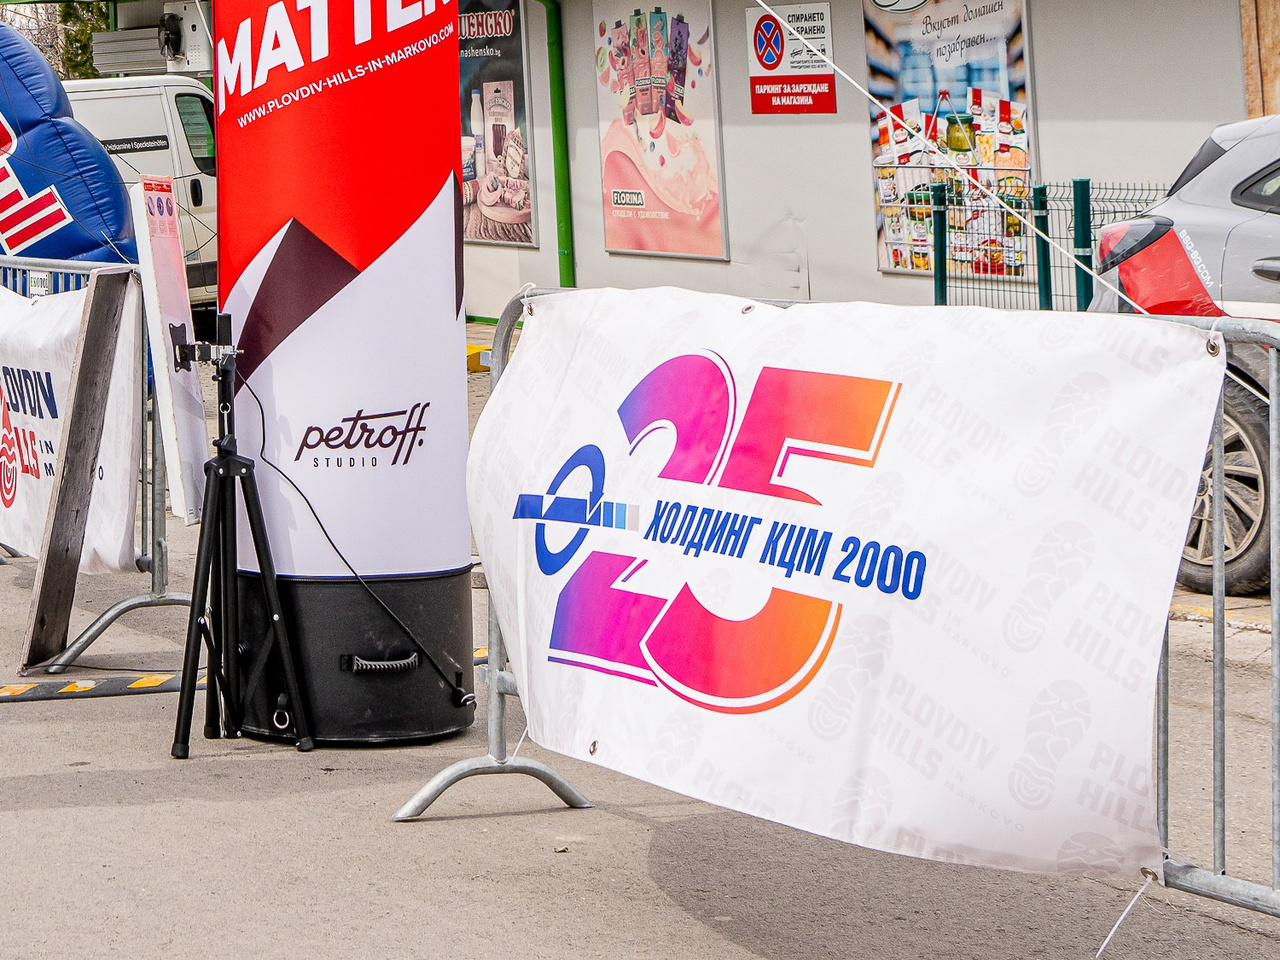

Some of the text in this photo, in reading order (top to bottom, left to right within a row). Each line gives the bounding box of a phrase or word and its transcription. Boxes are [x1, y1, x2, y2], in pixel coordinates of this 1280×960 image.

[787, 12, 825, 23] СПИРАНЕТО
[788, 25, 826, 36] ЗБРАНЕНО
[237, 22, 454, 128] WWW.PLOVDIV-HILLS-IN-MARKOVO.COM
[755, 84, 782, 94] ПАРКИНГ
[613, 191, 644, 206] FLORINA
[40, 440, 55, 454] IN
[313, 457, 378, 468] STUDIO
[644, 499, 927, 600] ХОЛДИНГ КЦМ 2000
